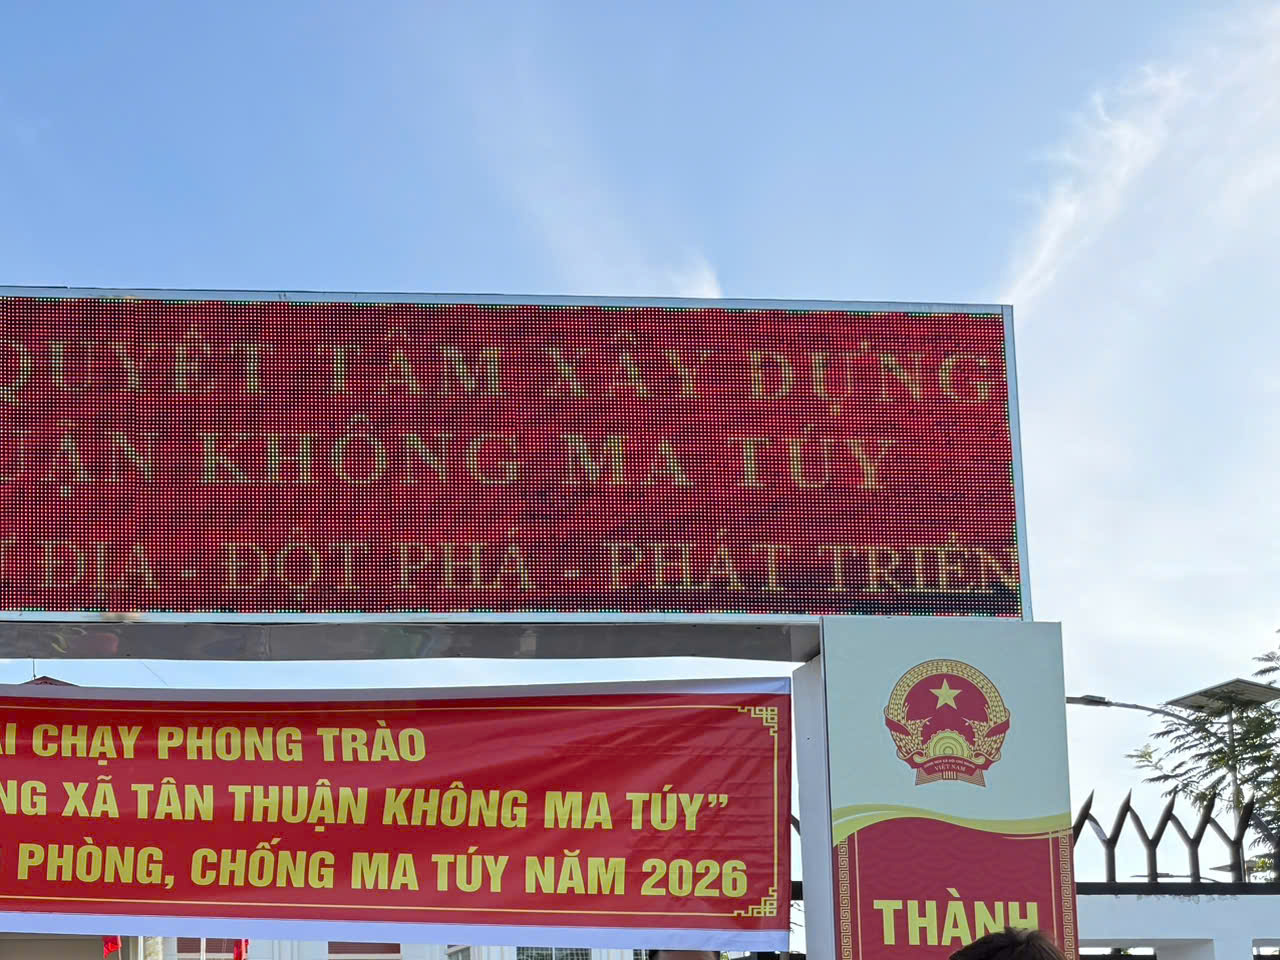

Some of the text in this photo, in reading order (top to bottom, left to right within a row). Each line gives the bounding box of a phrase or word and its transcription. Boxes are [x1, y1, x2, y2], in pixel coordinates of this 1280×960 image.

[317, 328, 508, 397] TÂM
[543, 330, 714, 399] XÂY
[745, 340, 999, 417] DỰNG
[198, 413, 525, 486] KHÔNG
[560, 432, 694, 488] MA
[727, 424, 897, 491] TÚY
[37, 539, 160, 600] ĐỊA
[221, 526, 369, 601] ĐỘT
[391, 526, 538, 592] PHÁ
[602, 526, 792, 593] PHÁT
[32, 723, 141, 766] CHẠY
[158, 727, 303, 762] PHONG
[317, 720, 427, 762] TRÀO
[62, 776, 120, 819] XÃ
[131, 777, 214, 821] TÂN
[229, 779, 368, 833] THUẬN
[382, 779, 528, 829] KHÔNG
[543, 791, 613, 831] MA
[626, 785, 729, 831] TÚY”
[17, 838, 175, 889] PHÒNG,
[190, 834, 335, 889] CHỐNG
[350, 852, 419, 891] MA
[431, 847, 509, 893] TÚY
[524, 849, 626, 896] NĂM
[640, 859, 748, 898] 2026
[873, 887, 1039, 946] THÀNH
